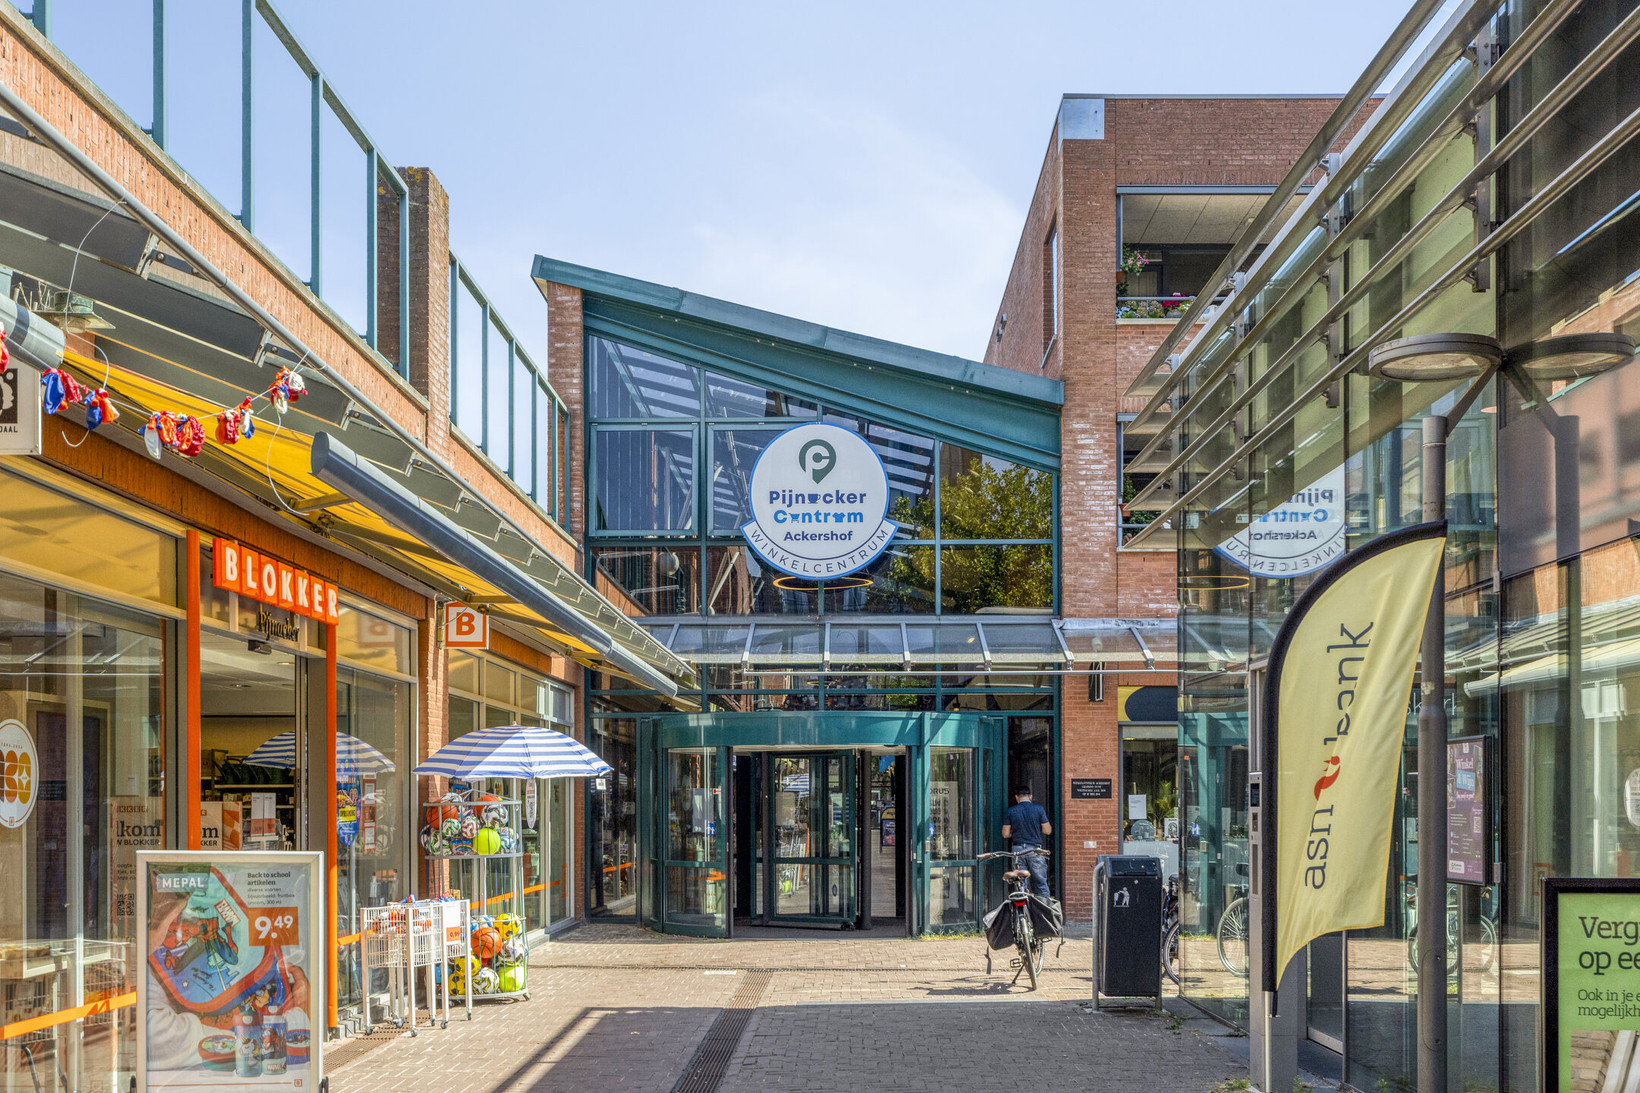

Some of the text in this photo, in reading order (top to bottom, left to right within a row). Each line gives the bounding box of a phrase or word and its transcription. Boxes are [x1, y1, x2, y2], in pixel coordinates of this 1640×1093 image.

[783, 530, 853, 541] Ackershof
[751, 529, 889, 574] WINKELCENTRUM
[225, 546, 338, 618] BLOKKER
[456, 612, 476, 636] B
[1305, 804, 1334, 890] asn
[162, 877, 205, 889] MEPAL
[1578, 916, 1640, 946] Verg
[1578, 951, 1612, 976] op
[1577, 988, 1604, 1001] Ook
[1606, 989, 1619, 1001] in
[1621, 989, 1634, 1005] je
